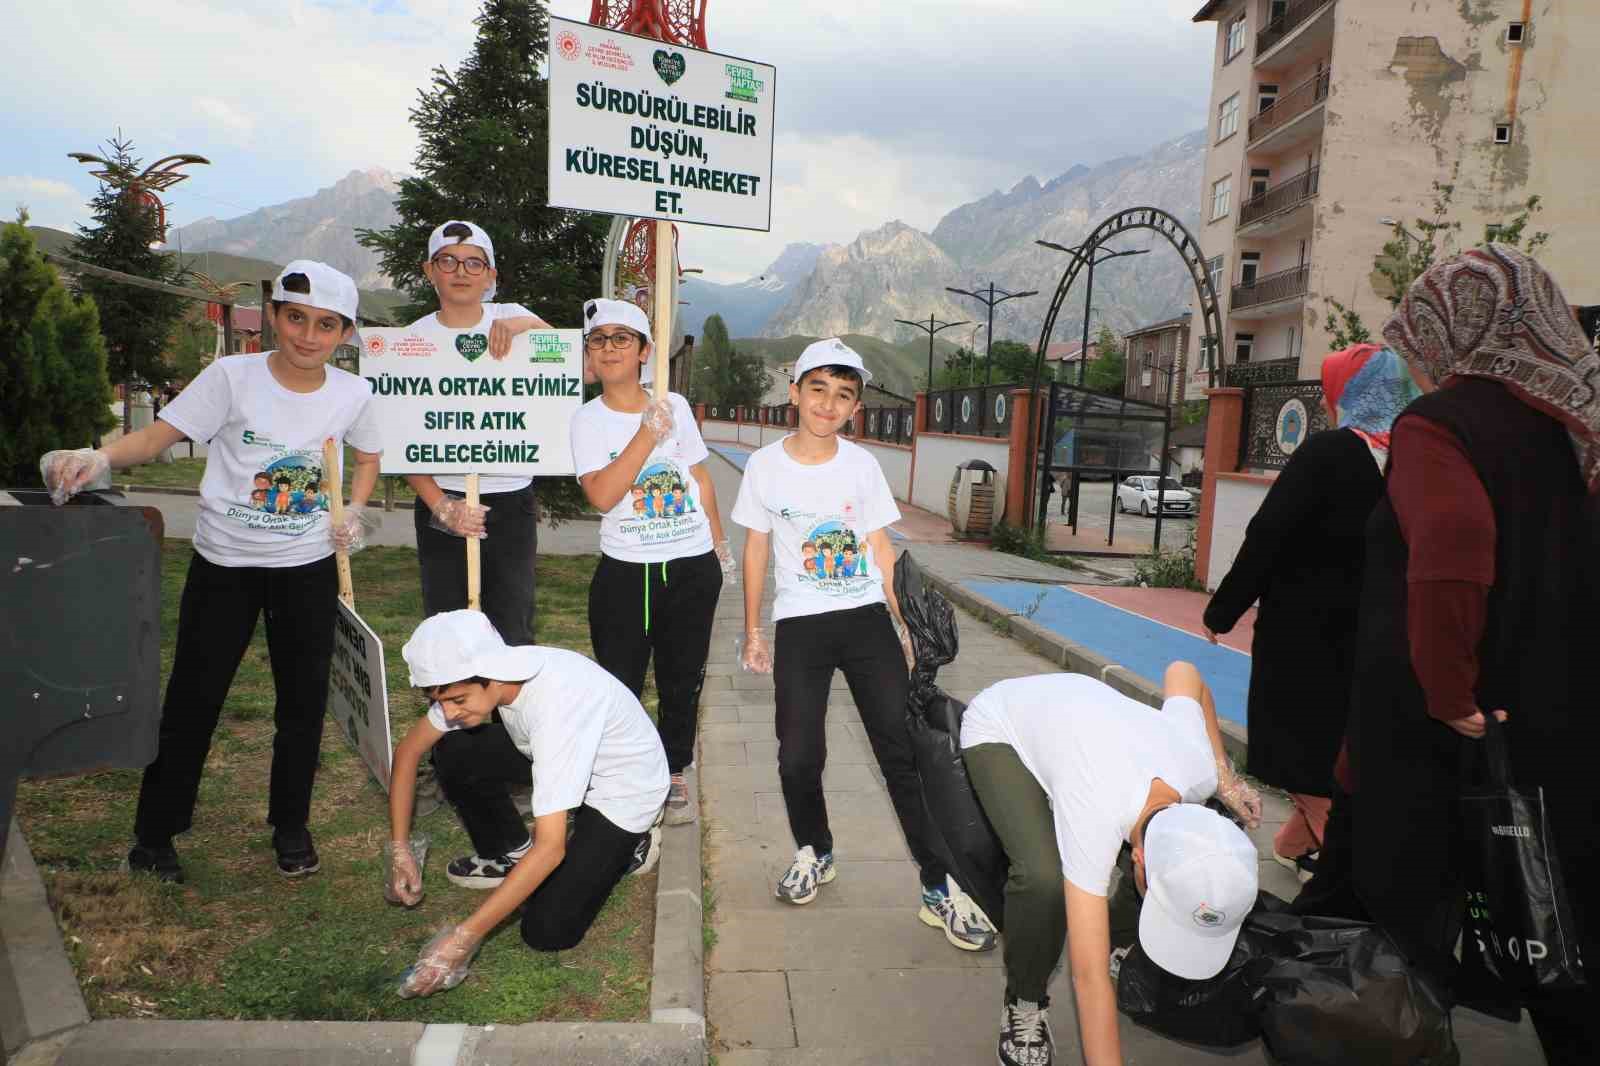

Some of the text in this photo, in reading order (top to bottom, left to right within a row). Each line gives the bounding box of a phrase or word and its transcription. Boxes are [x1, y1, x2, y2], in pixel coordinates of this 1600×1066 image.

[576, 81, 757, 136] SÜRDÜRÜLEBİLİR
[631, 124, 708, 164] DÜŞÜN,
[565, 147, 760, 196] KÜRESEL HAREKET
[655, 191, 683, 214] ET.
[439, 377, 506, 396] ORTAK
[512, 374, 580, 397] EVİMİZ
[424, 411, 527, 430] SIFIR ATIK
[242, 430, 255, 444] 5
[405, 440, 539, 463] GELECEĞİMİZ
[227, 507, 259, 521] Dünya
[620, 524, 646, 534] Dünya
